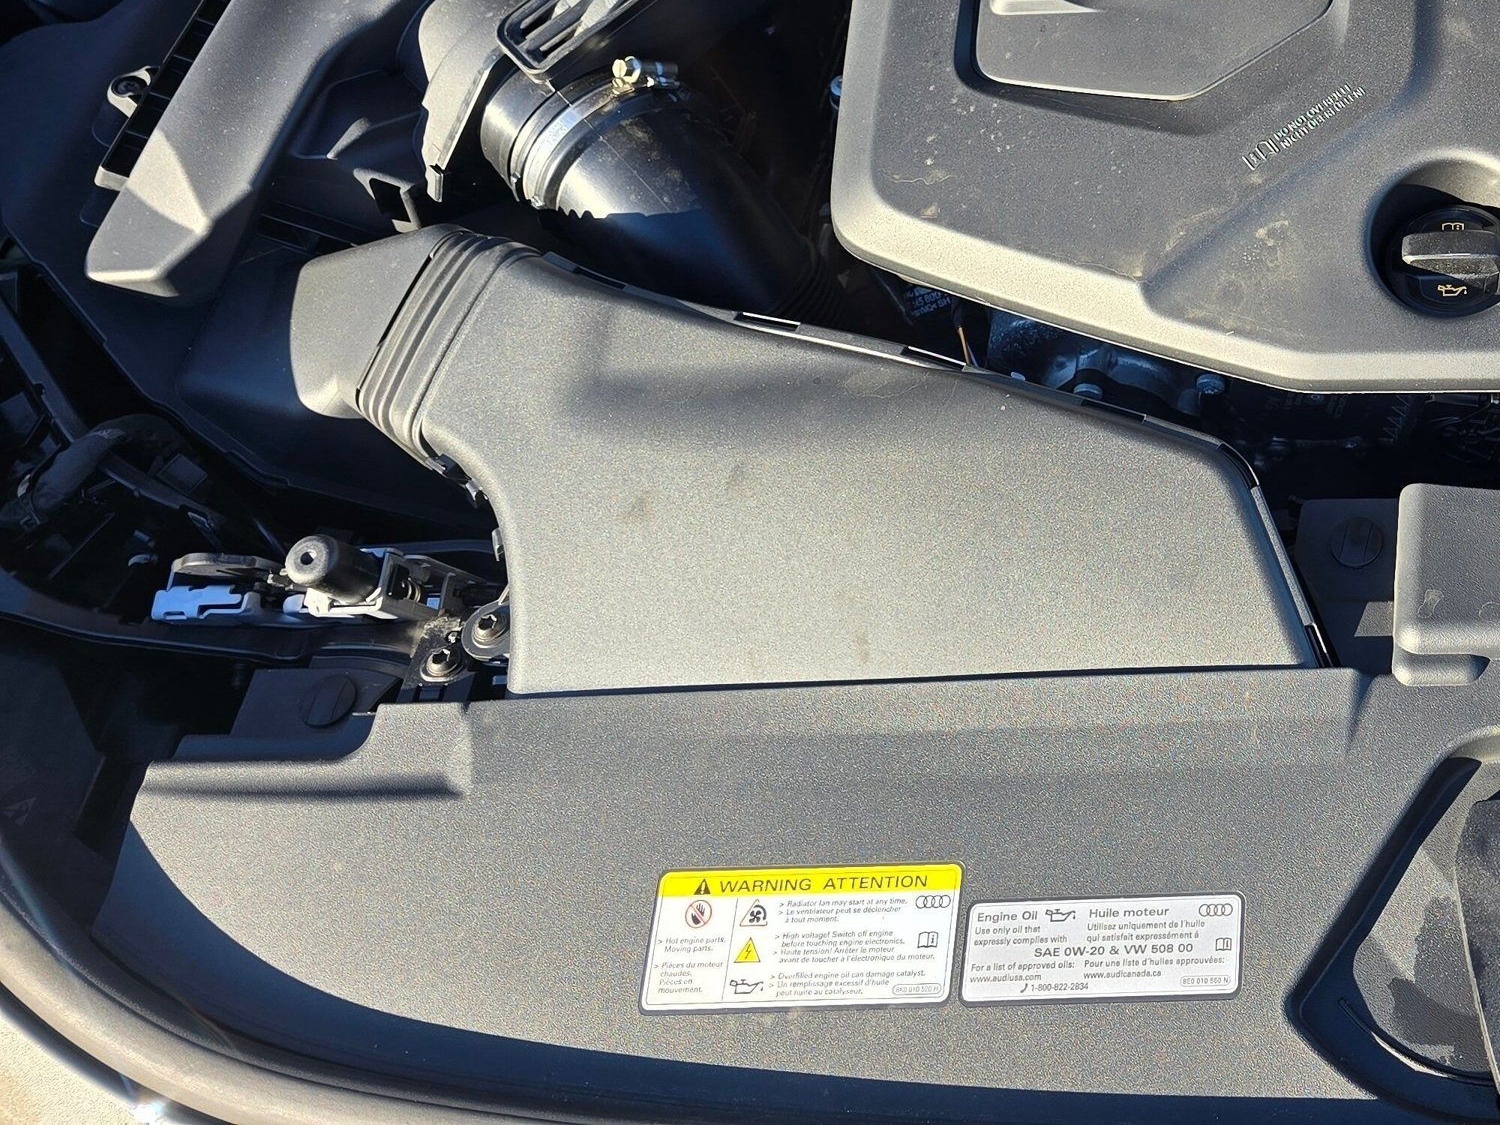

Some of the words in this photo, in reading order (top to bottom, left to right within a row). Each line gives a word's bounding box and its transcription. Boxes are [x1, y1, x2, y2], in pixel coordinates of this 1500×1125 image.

[720, 878, 811, 893] WARNING
[824, 875, 928, 890] ATTENTION
[978, 912, 1018, 923] Engine
[1022, 911, 1038, 920] Oil
[1089, 908, 1120, 918] Huile
[1124, 908, 1170, 917] moteur
[975, 927, 990, 935] Use
[993, 926, 1011, 935] only
[1013, 925, 1023, 934] oil
[1025, 925, 1041, 934] that
[1088, 923, 1116, 931] Utilisez
[1118, 921, 1167, 931] uniquement
[1169, 921, 1179, 929] de
[783, 932, 800, 940] High
[802, 931, 830, 940] voltage!
[870, 930, 894, 938] engine
[1087, 934, 1100, 943] qui
[1102, 933, 1134, 942] satisfait
[1136, 931, 1192, 943] expressément
[680, 936, 704, 945] engine
[781, 940, 804, 948] before
[807, 939, 837, 947] touching
[839, 939, 864, 947] engine
[865, 937, 905, 945] electronics.
[974, 937, 1011, 947] expressly
[1013, 936, 1049, 945] complies
[1051, 935, 1068, 944] with
[664, 945, 691, 953] Moving
[803, 947, 833, 955] tension!
[1034, 948, 1060, 957] SAE
[1064, 946, 1105, 956] 0W-20
[1109, 947, 1120, 955] &
[1124, 945, 1148, 955] VW
[1151, 944, 1174, 954] 508
[1178, 943, 1193, 953] 00
[971, 963, 984, 972] For
[994, 963, 1005, 971] list
[1008, 962, 1016, 970] of
[1018, 961, 1056, 971] approved
[1058, 961, 1075, 969] oils:
[1084, 959, 1103, 968] Pour
[1123, 958, 1140, 967] liste
[778, 972, 813, 980] Overfilled
[815, 972, 839, 980] engine
[866, 971, 895, 979] damage
[897, 970, 926, 978] catalyst.
[970, 974, 1042, 983] www.audiusa.com
[1084, 970, 1162, 979] www.audicanada.ca
[790, 980, 833, 988] remplissage
[835, 979, 864, 987] excessif
[1031, 982, 1089, 992] 1-800-822-2834
[776, 990, 792, 998] peut
